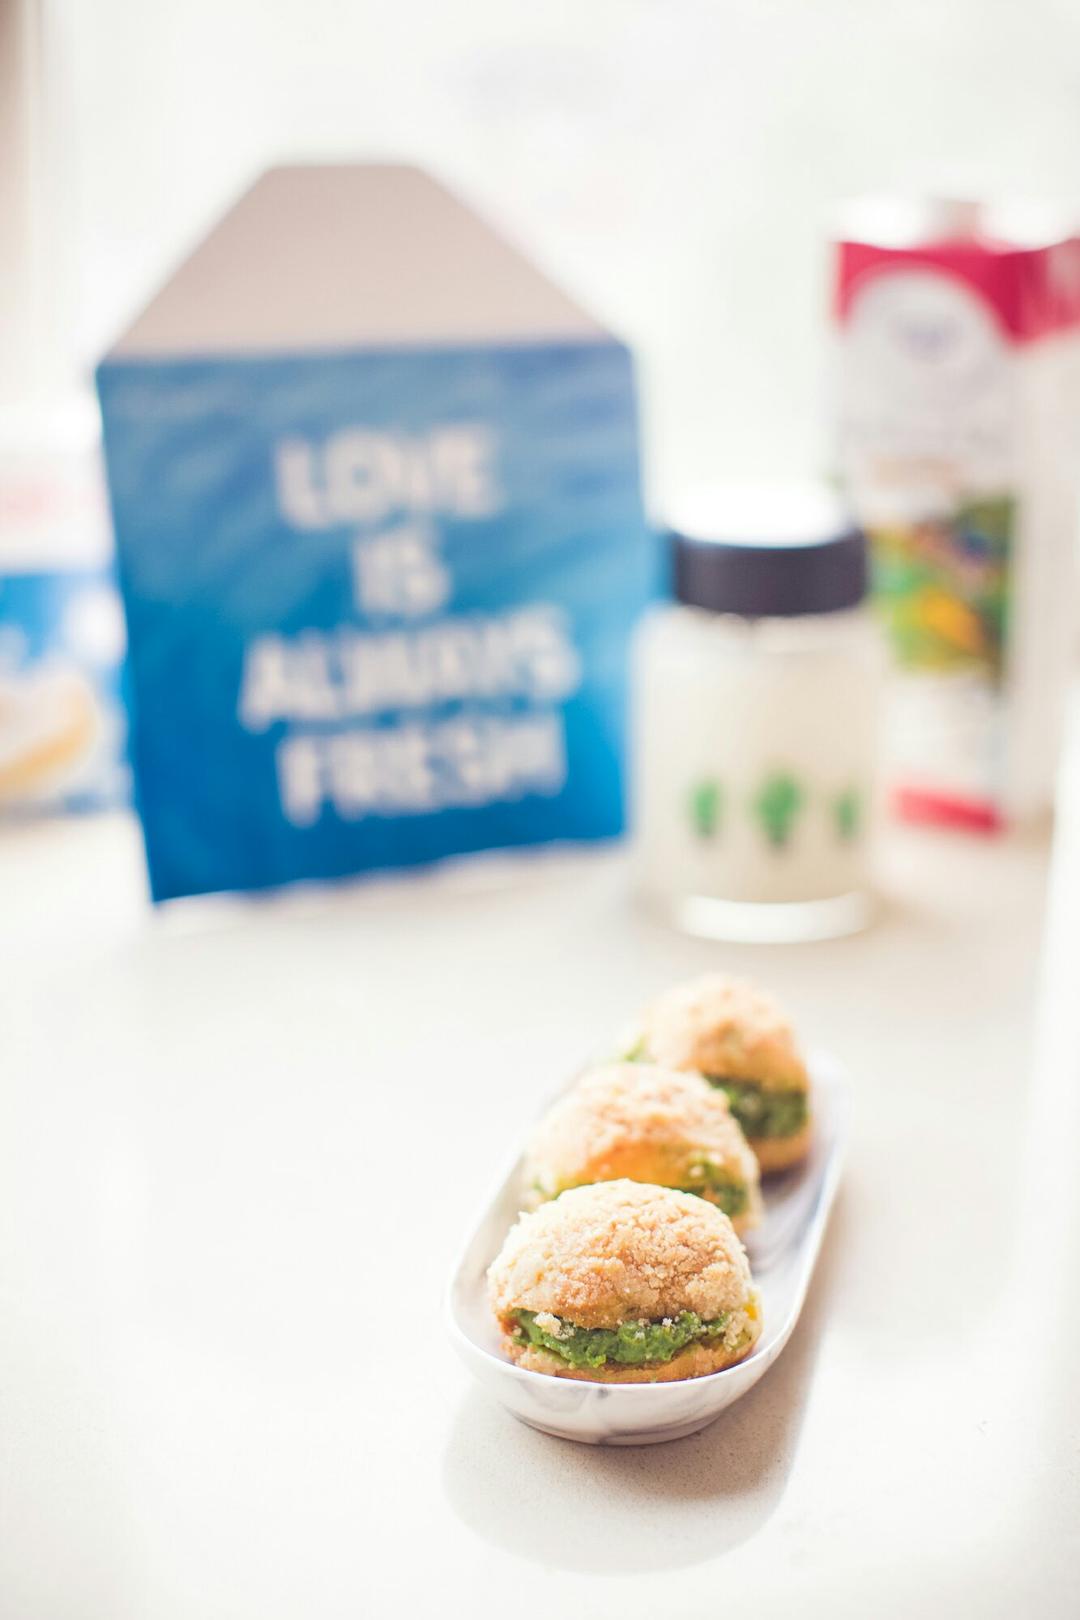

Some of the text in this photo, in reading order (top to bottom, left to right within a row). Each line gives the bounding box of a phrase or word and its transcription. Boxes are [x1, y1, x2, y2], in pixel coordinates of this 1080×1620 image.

[276, 426, 498, 528] LOVE
[355, 524, 450, 613] IS
[240, 606, 578, 730] ALWAYS
[278, 715, 566, 825] FRESH
